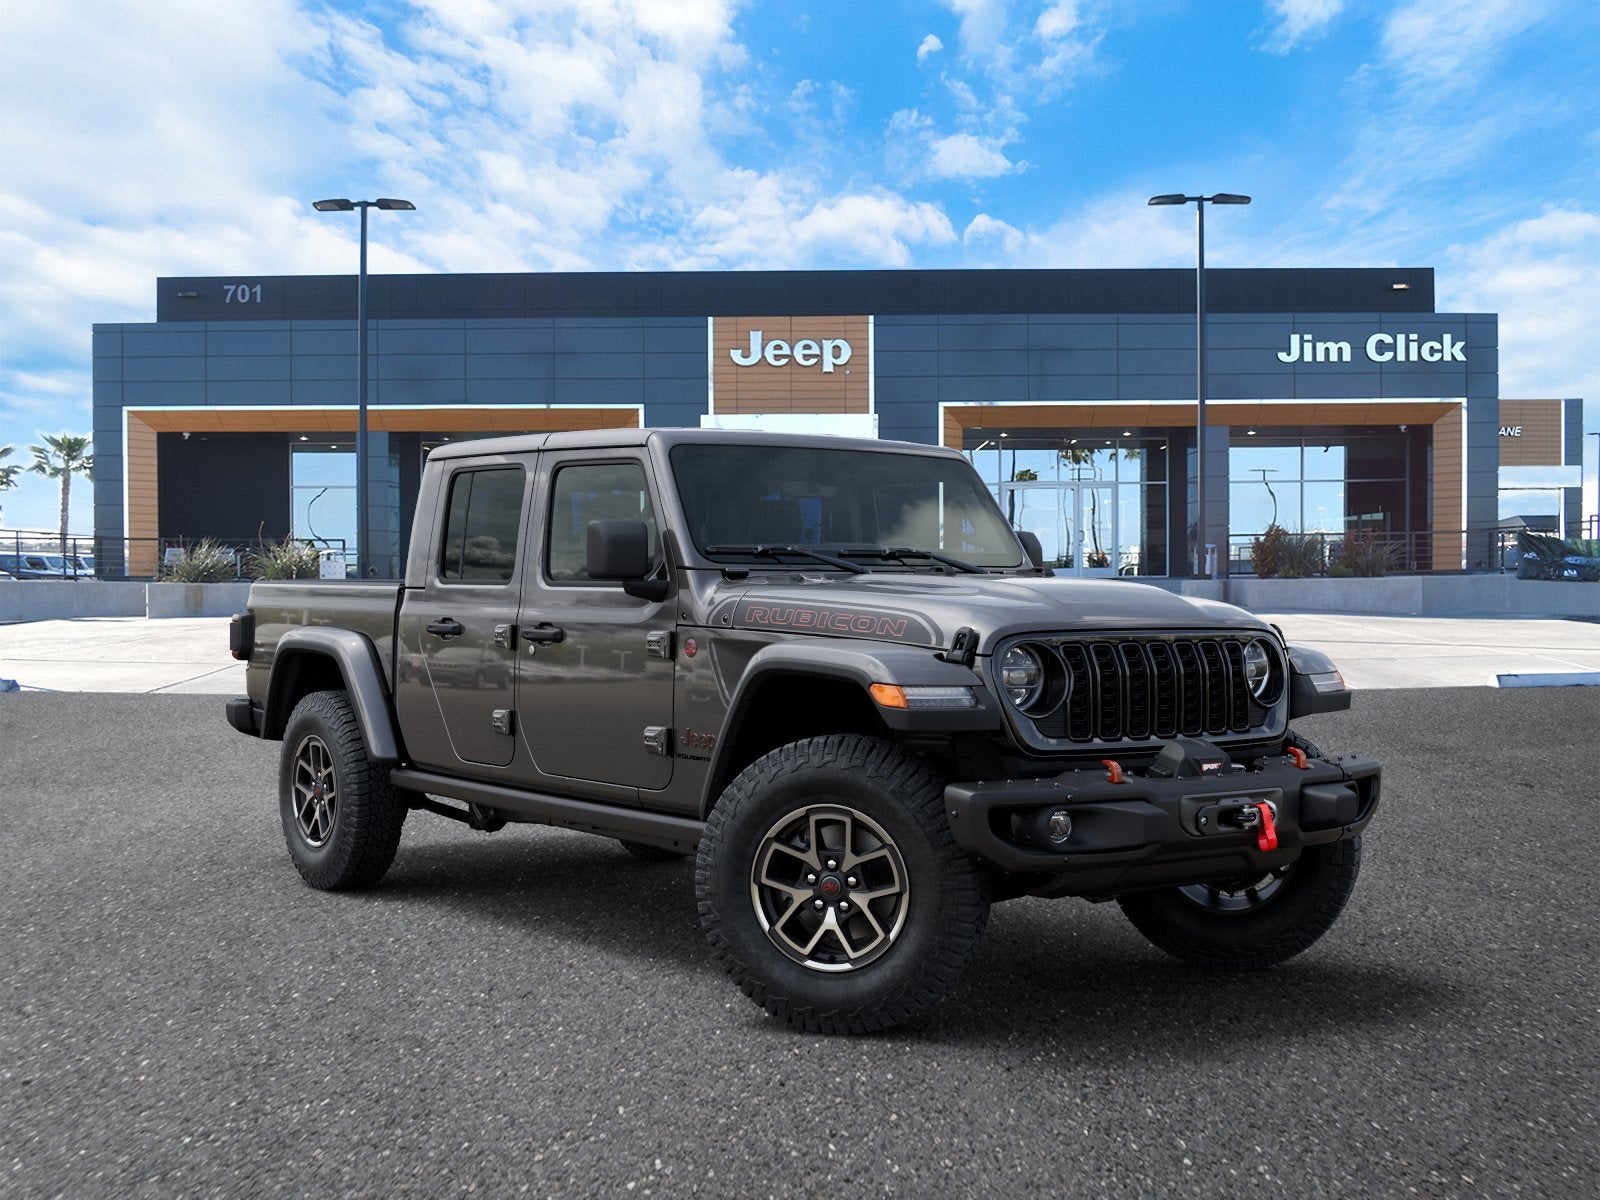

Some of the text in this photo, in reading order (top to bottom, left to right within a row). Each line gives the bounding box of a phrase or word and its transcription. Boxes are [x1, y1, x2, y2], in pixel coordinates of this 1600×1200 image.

[223, 284, 262, 303] 701
[729, 330, 852, 373] Jeep
[1277, 333, 1467, 363] Jim Click
[1498, 426, 1523, 437] ANE
[745, 606, 908, 637] RUBICON
